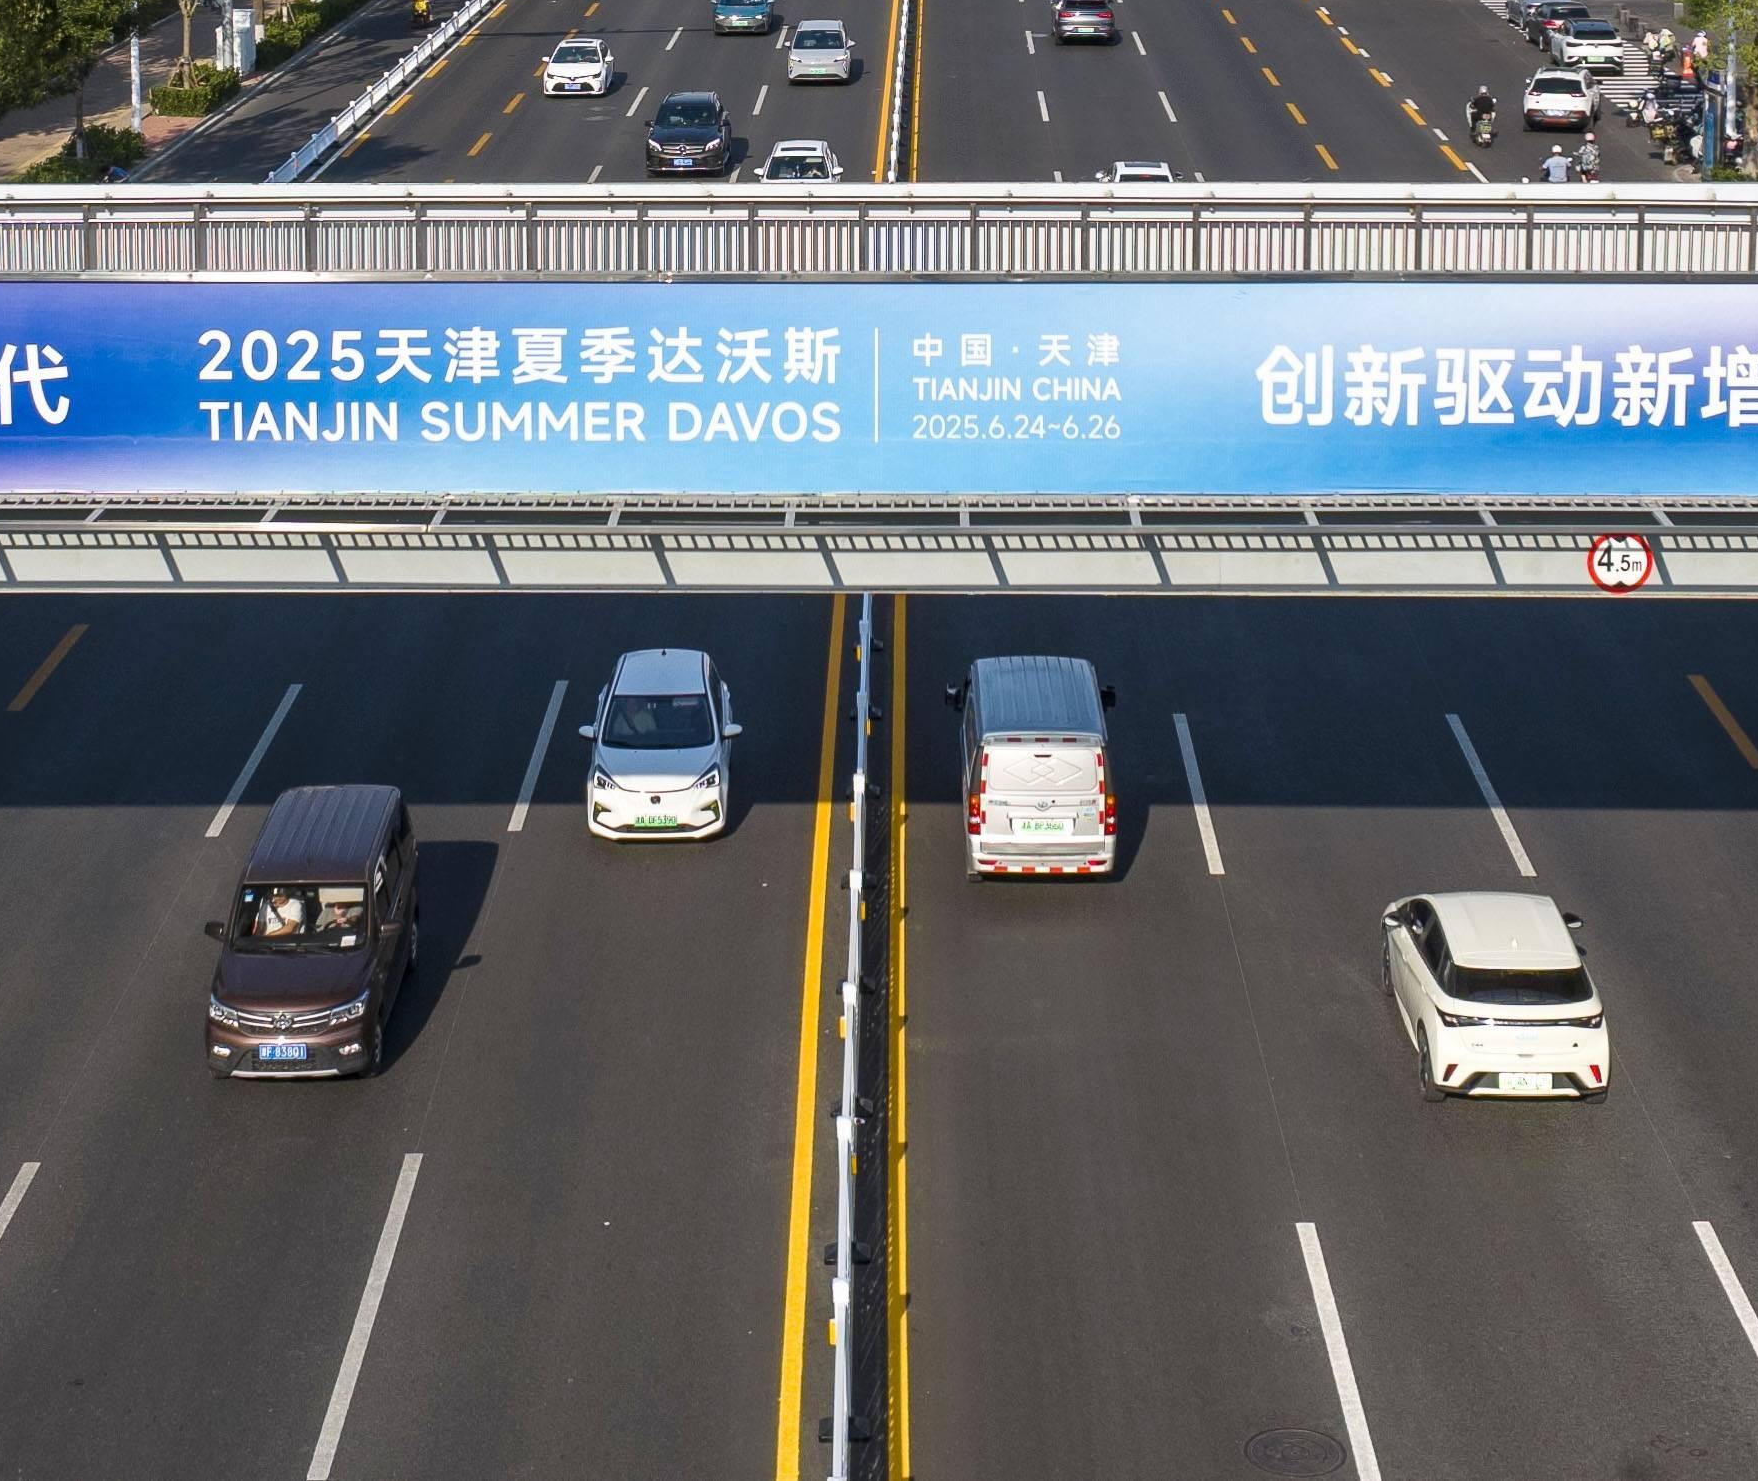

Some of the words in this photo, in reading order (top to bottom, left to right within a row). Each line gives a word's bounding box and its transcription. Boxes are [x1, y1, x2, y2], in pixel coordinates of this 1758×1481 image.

[197, 325, 842, 385] 2025天津夏季达沃斯
[913, 377, 1022, 401] TIANJIN
[1031, 377, 1122, 401] CHINA
[199, 401, 398, 443] TIANJIN
[421, 401, 645, 443] SUMMER
[668, 401, 842, 443] DAVOS
[912, 414, 1122, 441] 2025.6.24~6.26
